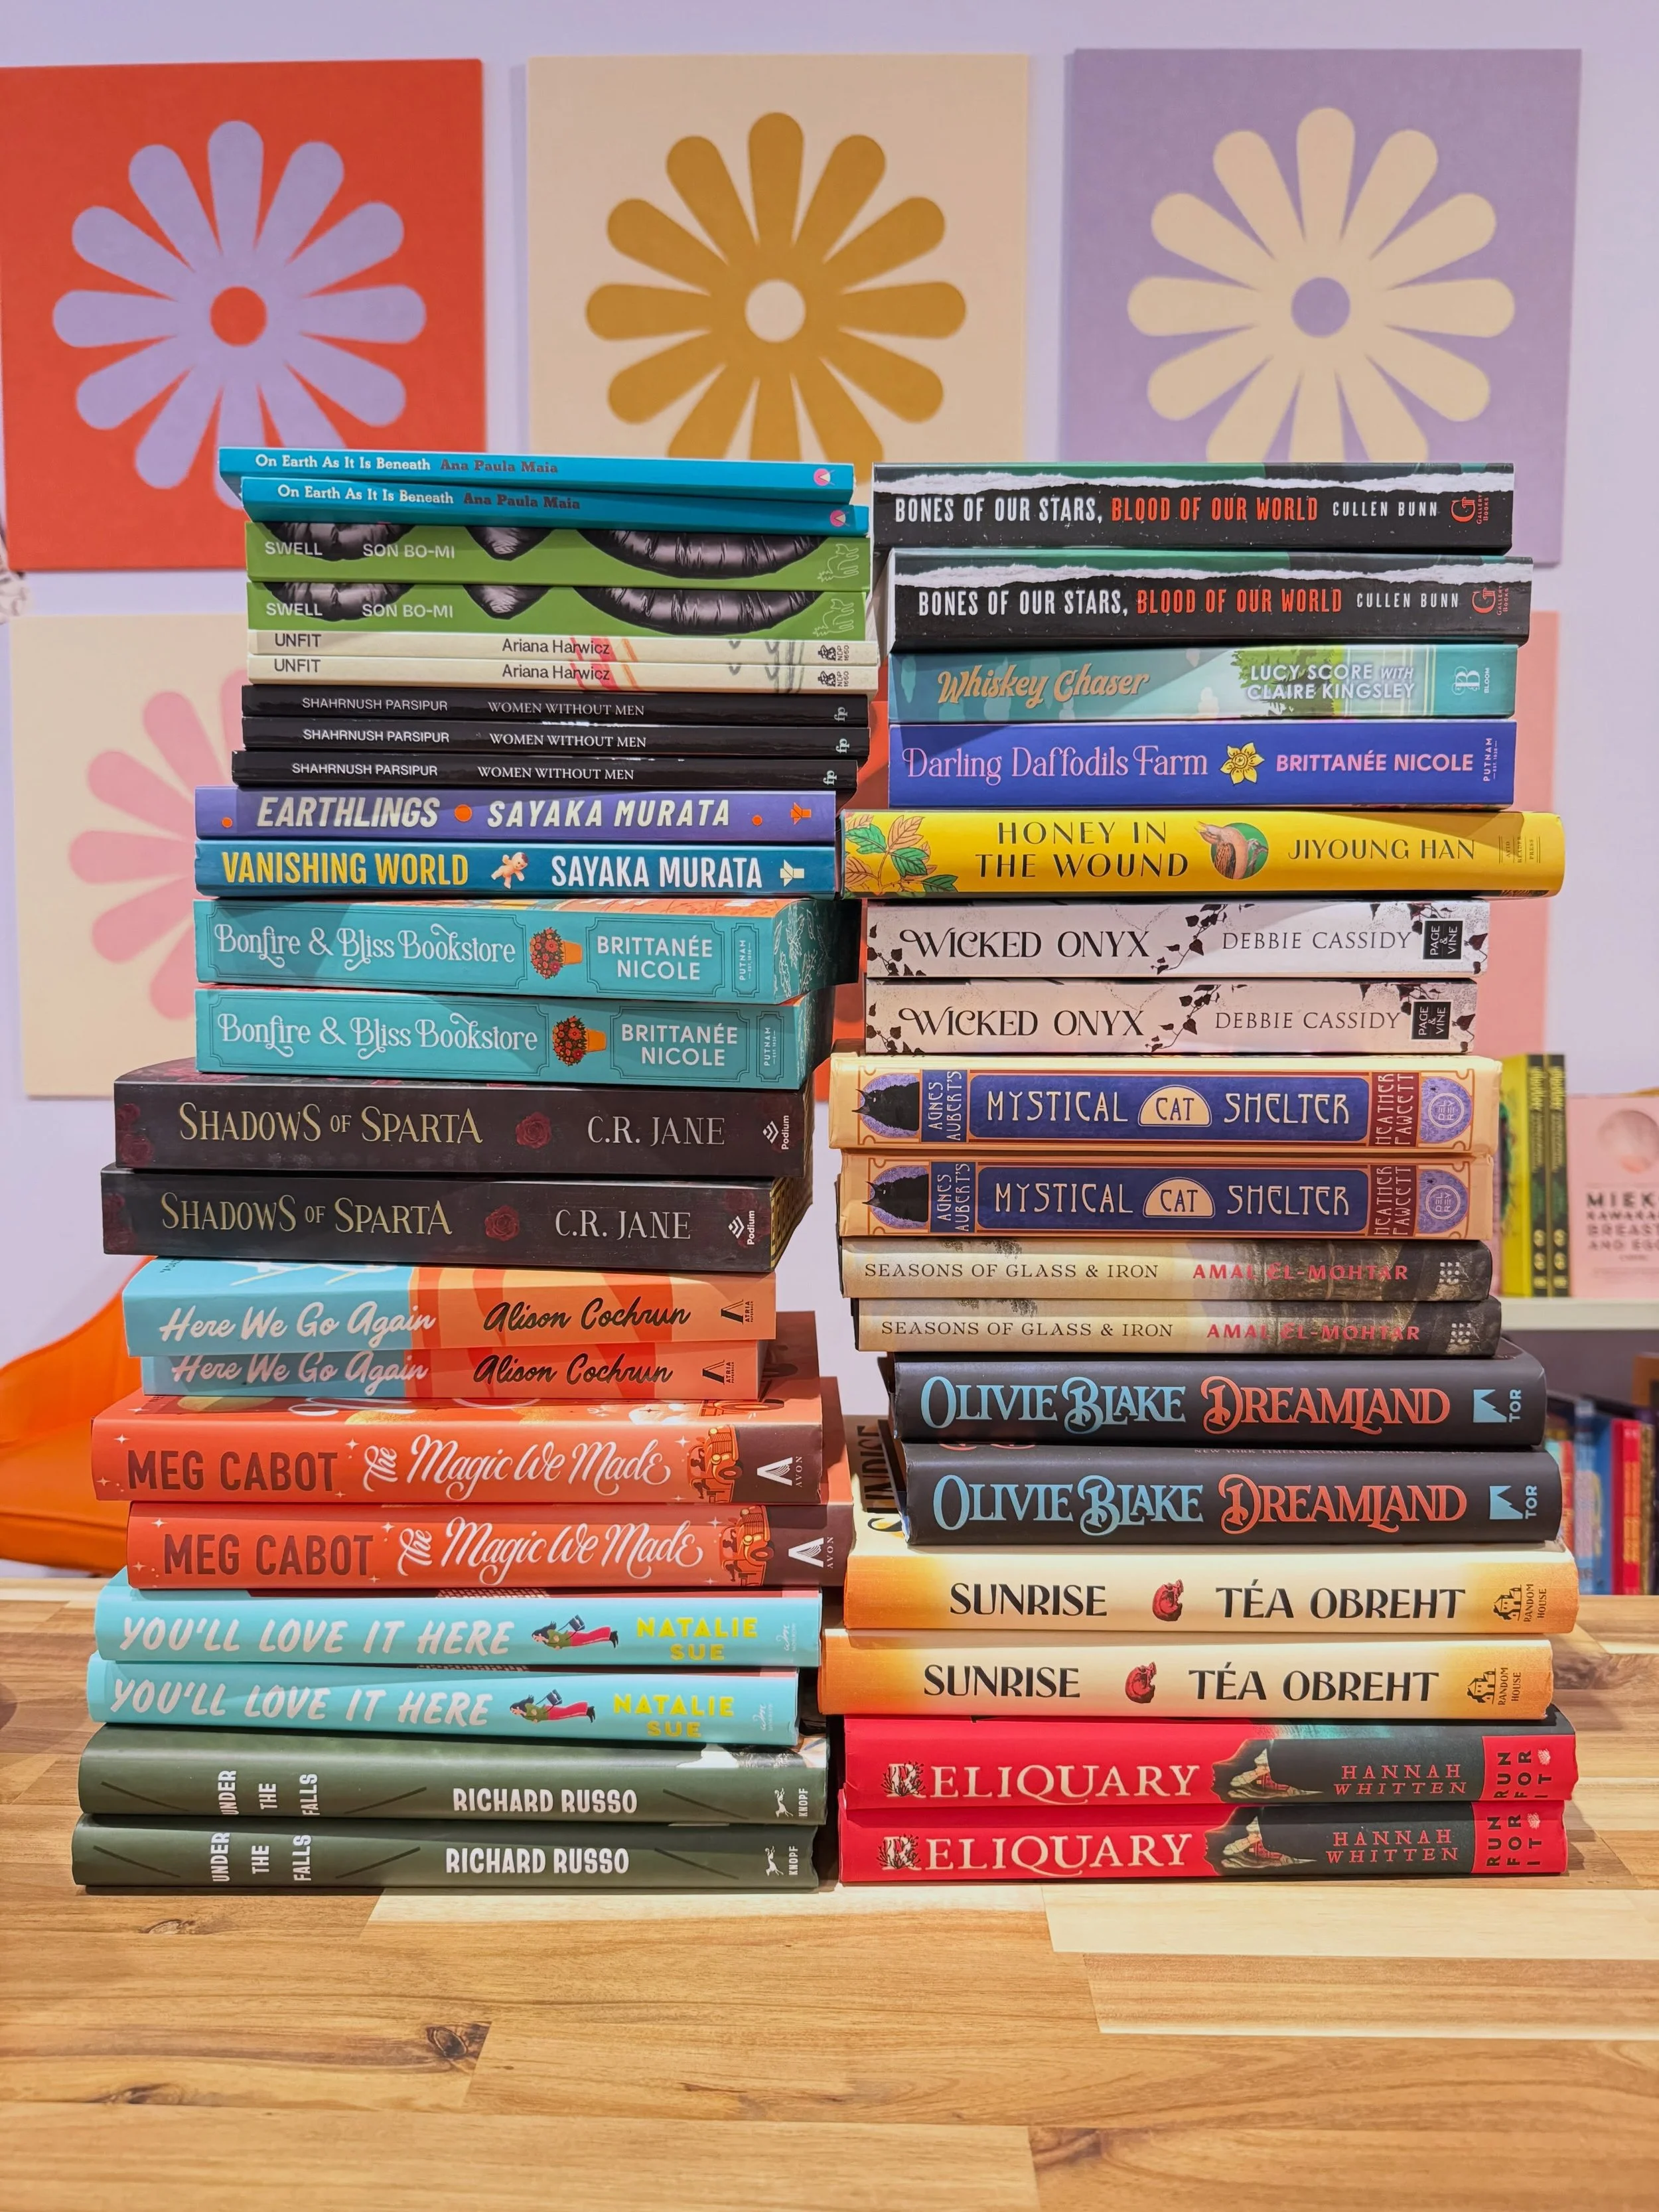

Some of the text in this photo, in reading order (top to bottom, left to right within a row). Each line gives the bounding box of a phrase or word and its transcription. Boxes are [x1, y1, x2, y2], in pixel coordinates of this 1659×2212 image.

[255, 454, 430, 471] On Earth As It Is Beneath
[441, 459, 558, 473] Ana Paula Maia
[895, 496, 1438, 524] BONES OF OUR STARS, BLOOD OF OUR WORLD CULLEN BUNN
[265, 542, 323, 555] SWELL
[363, 544, 455, 559] SON BO-MI
[275, 634, 321, 647] UNFIT
[502, 638, 610, 654] Ariana Harwicz
[937, 663, 1149, 709] Whiskey Chaser
[1251, 664, 1413, 681] LUCY SCORE WITH
[1247, 683, 1415, 700] CLAIRE KINGSLEY
[303, 729, 449, 743] SHAHRNUSH PARSIPUR
[490, 733, 646, 747] WOMEN WITHOUT MEN
[902, 745, 1208, 786] Darling Daffodils Farm
[1276, 750, 1473, 772] BRITTANÉE NICOLE
[1483, 738, 1492, 781] PUTNAM
[257, 797, 440, 828] EARTHLINGS
[487, 800, 729, 828] SAYAKA MURATA
[998, 822, 1167, 844] HONEY IN
[1288, 839, 1475, 860] JIYOUNG HAN
[222, 852, 468, 885] VANISHING WORLD
[551, 855, 762, 888] SAYAKA MURATA
[975, 853, 1188, 878] THE WOUND
[214, 923, 515, 971] Bonfire & Bliss Bookstore
[597, 934, 712, 957] BRITTANÉE
[900, 927, 1149, 958] WICKED ONYX
[1222, 932, 1412, 950] DEBBIE CASSIDY
[1430, 926, 1440, 956] PAGE
[1439, 936, 1447, 946] &
[1447, 926, 1457, 954] VINE
[617, 960, 700, 980] NICOLE
[928, 1082, 943, 1130] AGNES
[946, 1070, 962, 1141] AUBERT'S
[987, 1091, 1128, 1122] MYSTICAL
[1156, 1097, 1194, 1120] CAT
[1224, 1093, 1349, 1124] SHELTER
[1375, 1073, 1394, 1145] HEATHER
[1395, 1073, 1414, 1145] FAWCETT
[588, 1116, 724, 1146] C.R. JANE
[865, 1264, 1158, 1278] SEASONS OF GLASS & IRON
[1192, 1264, 1408, 1280] AMAL EL-MOHTAR
[159, 1301, 436, 1349] Here We Go Again
[483, 1296, 691, 1331] Alison Cochrun
[920, 1376, 1451, 1435] OLIVIE BLAKE DREAMLAND
[1508, 1389, 1522, 1423] TOR
[128, 1450, 204, 1490] MEG
[220, 1451, 338, 1491] CABOT
[363, 1445, 398, 1492] The
[407, 1434, 512, 1501] Magic
[513, 1441, 565, 1481] We
[950, 1583, 1107, 1617] SUNRISE
[1216, 1579, 1466, 1619] TÉA OBREHT
[1524, 1584, 1534, 1623] RANDOM
[1537, 1588, 1548, 1619] HOUSE
[119, 1617, 514, 1657] YOU'LL LOVE IT HERE
[637, 1617, 758, 1639] NATALIE
[670, 1644, 725, 1660] SUE
[1333, 1829, 1451, 1846] HANNAH
[1486, 1816, 1502, 1867] RUN
[1506, 1813, 1522, 1867] FOR
[1527, 1838, 1542, 1866] IT
[211, 1832, 230, 1882] UNDER
[252, 1845, 269, 1874] THE
[293, 1834, 312, 1881] FALLS
[446, 1848, 629, 1874] RICHARD RUSSO
[788, 1846, 798, 1876] KNOPF
[877, 1833, 1192, 1877] RELIQUARY
[1327, 1847, 1458, 1864] WHITTEN
